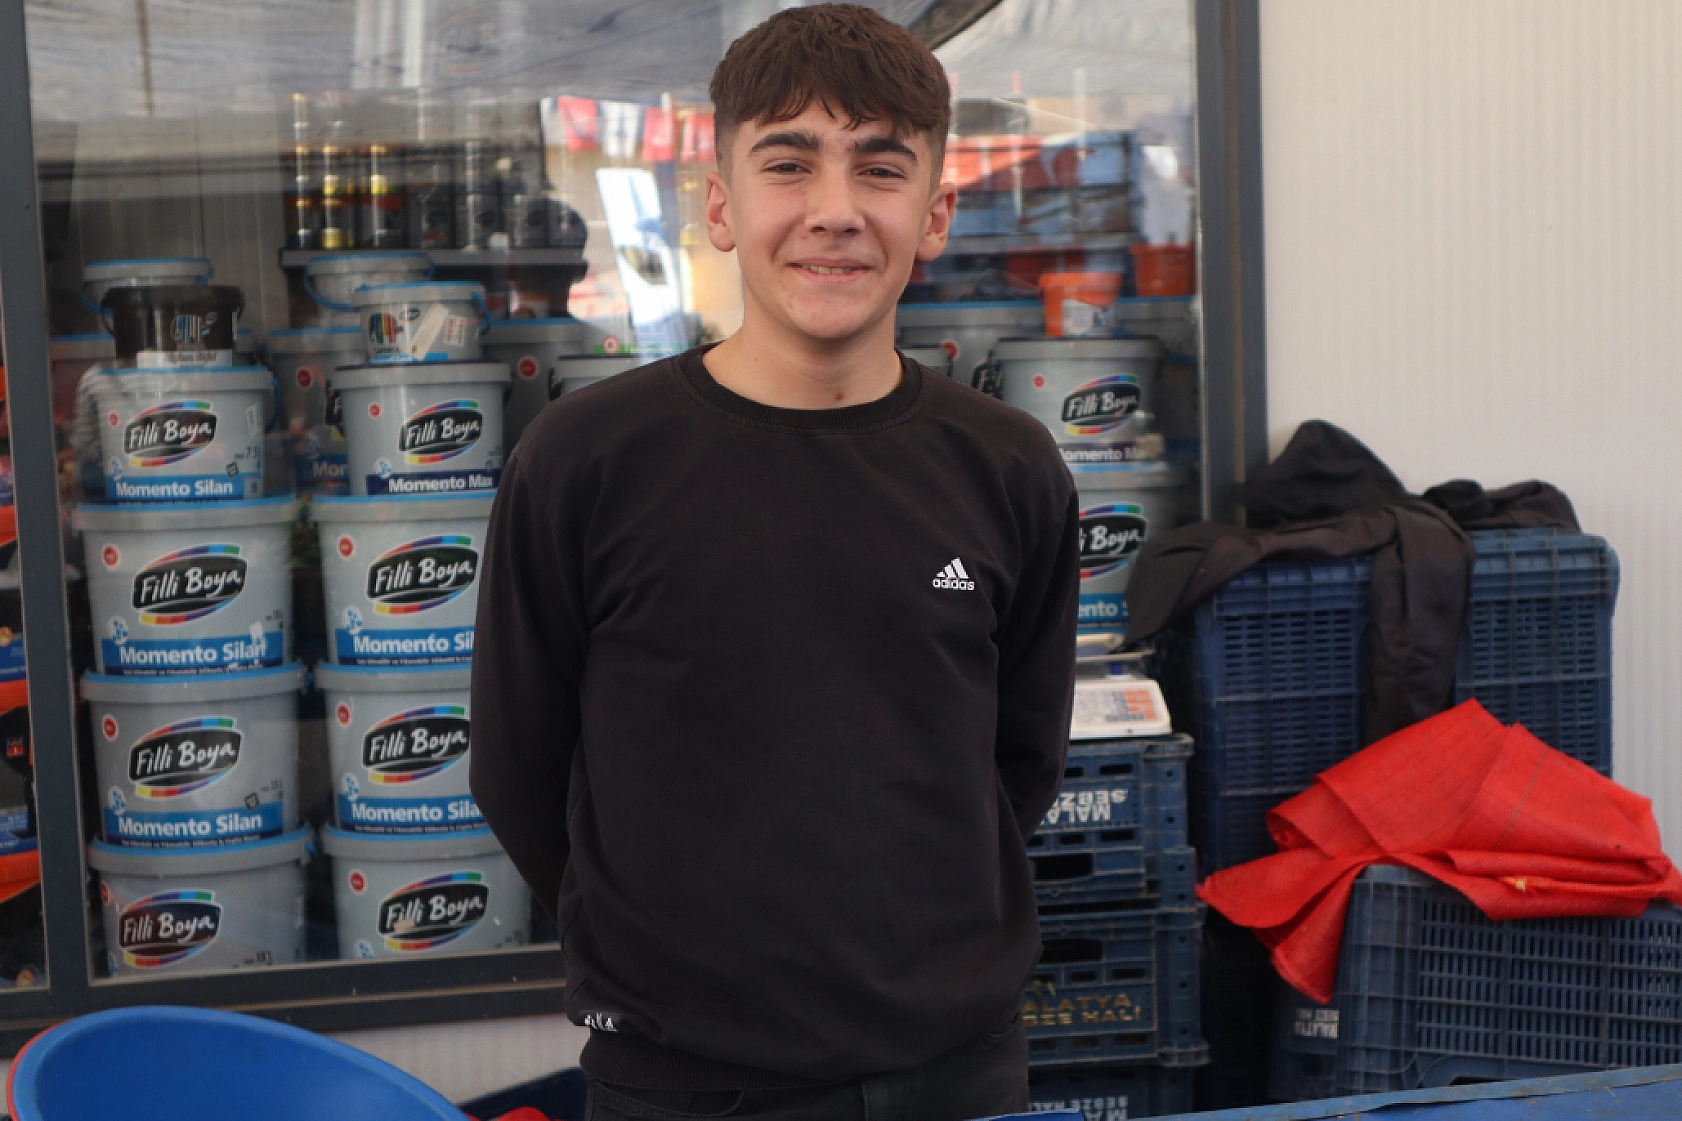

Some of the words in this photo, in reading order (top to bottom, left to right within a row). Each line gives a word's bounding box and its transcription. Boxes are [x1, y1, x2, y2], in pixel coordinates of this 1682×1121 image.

[129, 426, 158, 450] Filli
[164, 419, 212, 443] Boya
[405, 420, 436, 447] Filli
[115, 481, 190, 498] Momento
[194, 478, 234, 495] Silan
[388, 477, 466, 493] Momento
[1089, 525, 1144, 556] Boya
[140, 571, 180, 603] Filli
[184, 567, 242, 598] Boya
[374, 561, 413, 593] Filli
[417, 557, 474, 588] Boya
[932, 578, 975, 591] adidas
[120, 646, 217, 664] Momento
[221, 641, 268, 662] Silan
[353, 633, 450, 654] Momento
[135, 744, 172, 776] Filli
[177, 740, 235, 771] Boya
[369, 732, 404, 761] Filli
[410, 728, 467, 758] Boya
[118, 817, 211, 836] Momento
[215, 813, 263, 834] Silan
[351, 803, 443, 823] Momento
[386, 897, 424, 930] Filli
[429, 894, 484, 926] Boya
[123, 914, 154, 944] Filli
[157, 911, 216, 944] Boya
